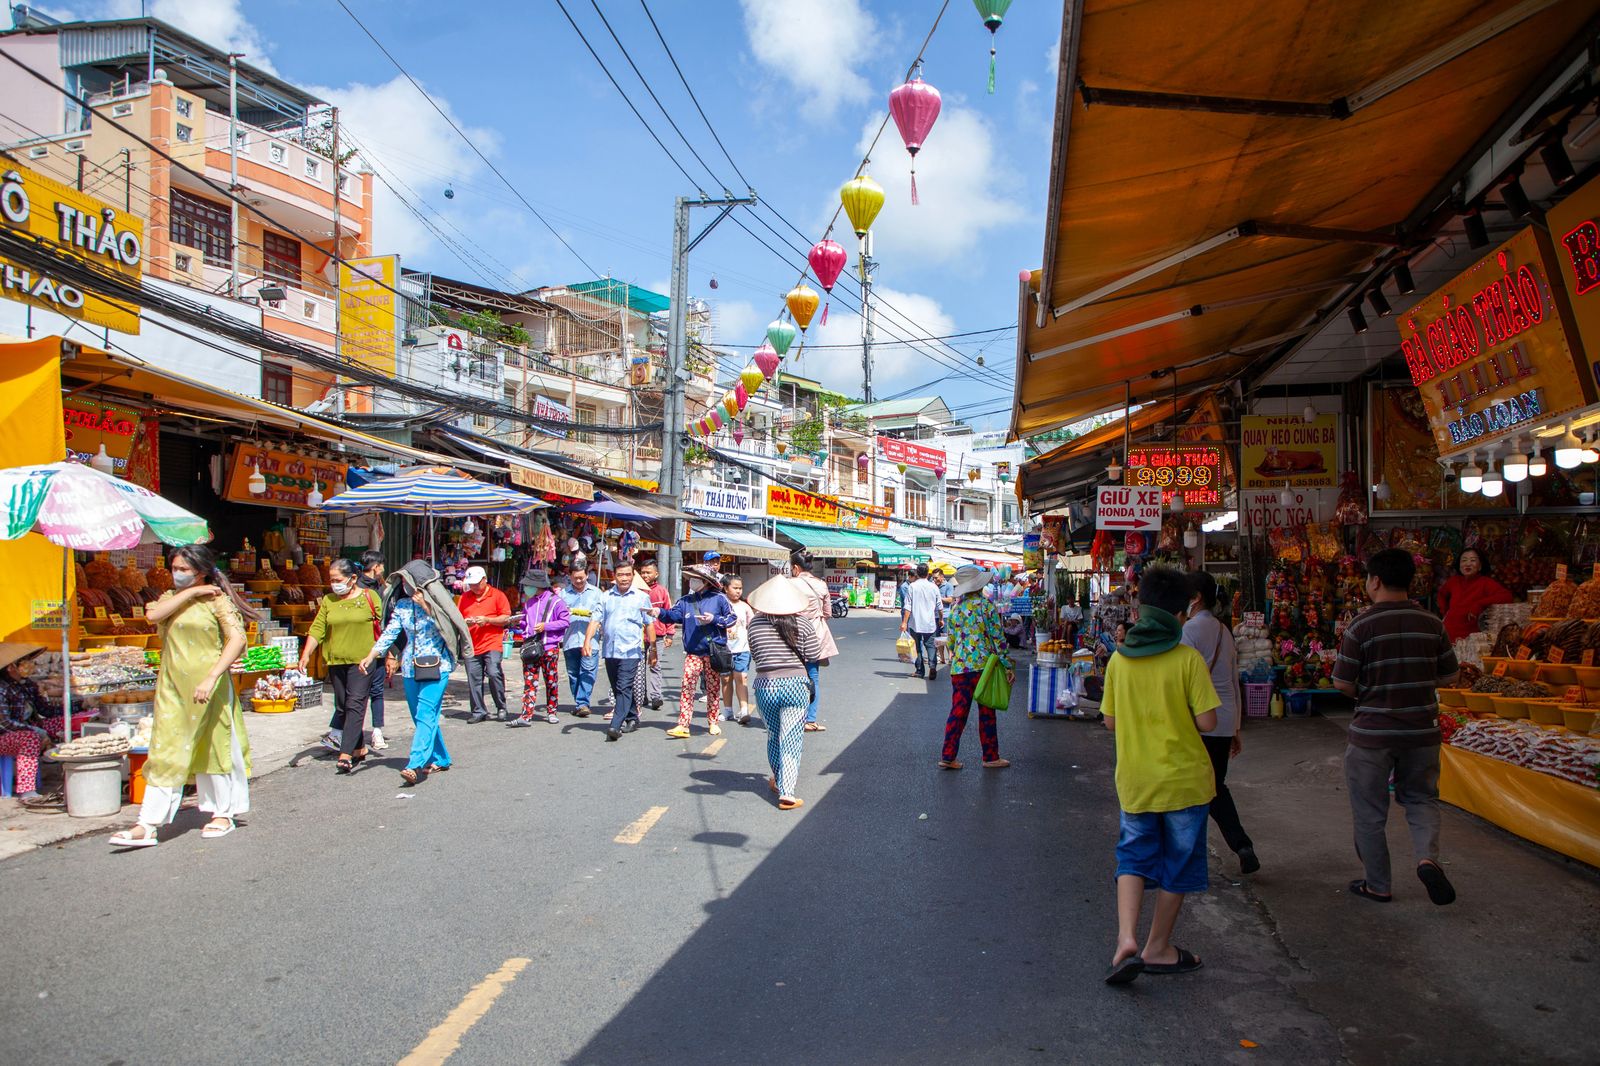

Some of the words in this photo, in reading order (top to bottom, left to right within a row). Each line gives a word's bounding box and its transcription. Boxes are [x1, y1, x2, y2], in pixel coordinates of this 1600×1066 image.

[54, 202, 141, 266] THẢO
[1401, 319, 1435, 387] BÀ
[1426, 294, 1480, 373] GIÁO
[1472, 250, 1543, 347] THẢO
[1243, 429, 1268, 448] QUAY
[1271, 428, 1290, 444] HEO
[1129, 450, 1148, 466] BÀ
[1150, 450, 1182, 467] GIÁO
[1184, 447, 1218, 466] THẢO
[1137, 466, 1212, 487] 9999
[706, 489, 724, 508] THÁI
[771, 489, 791, 504] NHÀ
[794, 493, 812, 510] TRỌ
[1100, 487, 1132, 506] GIỮ
[1136, 491, 1160, 505] XE
[1255, 492, 1278, 504] NHÀ
[1098, 507, 1135, 517] HONDA
[1140, 507, 1160, 517] 10K
[1286, 508, 1314, 526] NGA
[826, 574, 842, 584] GIỮ
[842, 576, 854, 584] XE
